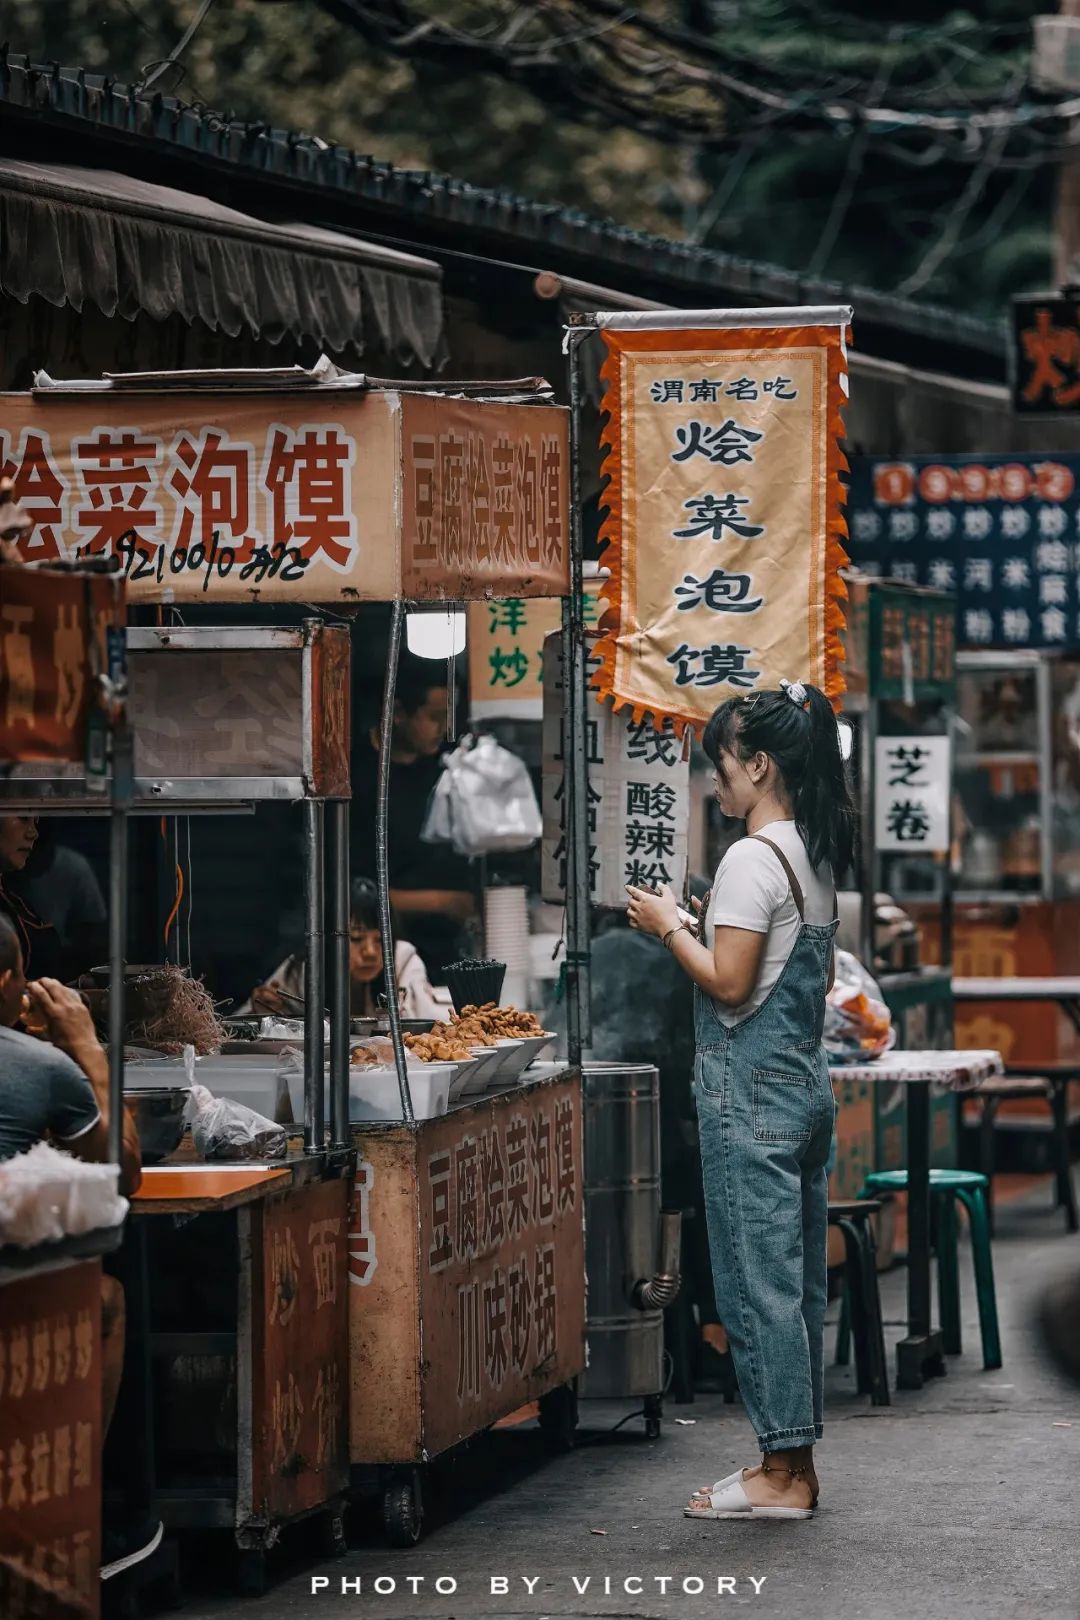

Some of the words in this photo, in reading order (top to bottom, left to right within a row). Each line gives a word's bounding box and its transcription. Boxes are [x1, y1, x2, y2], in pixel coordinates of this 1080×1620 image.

[650, 376, 798, 403] 渭南名吃
[74, 529, 235, 592] 9210010
[411, 432, 563, 567] 豆腐烩菜泡馍
[666, 419, 764, 688] 烩菜泡馍
[489, 647, 545, 688] 炒
[429, 1099, 575, 1270] 豆腐烩菜泡馍
[458, 1245, 556, 1399] 川味砂锅
